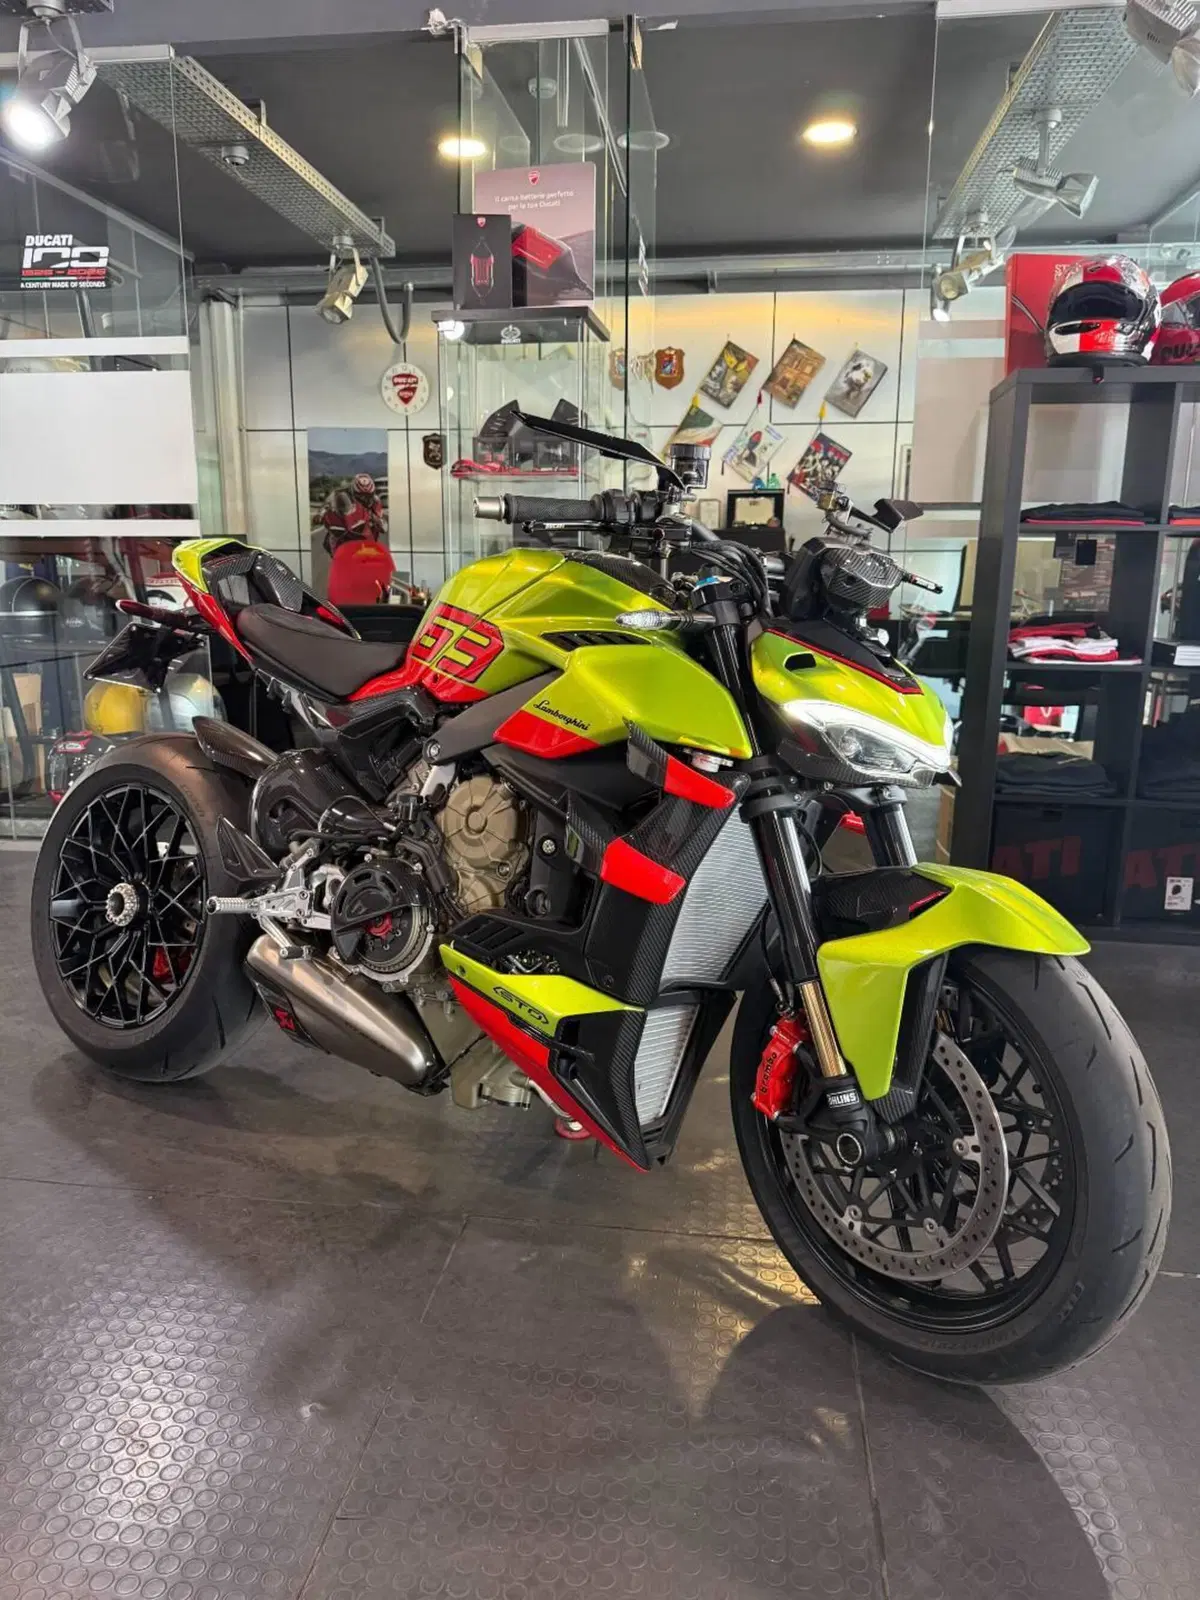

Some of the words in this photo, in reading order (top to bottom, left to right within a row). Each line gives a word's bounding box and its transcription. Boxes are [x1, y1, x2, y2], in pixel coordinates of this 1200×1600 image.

[546, 190, 574, 200] perfetto
[508, 204, 518, 212] per
[25, 234, 73, 246] DUCATI
[20, 281, 25, 289] A
[25, 281, 51, 289] CENTURY
[533, 700, 591, 731] Lamborghini
[760, 1051, 777, 1094] brembo
